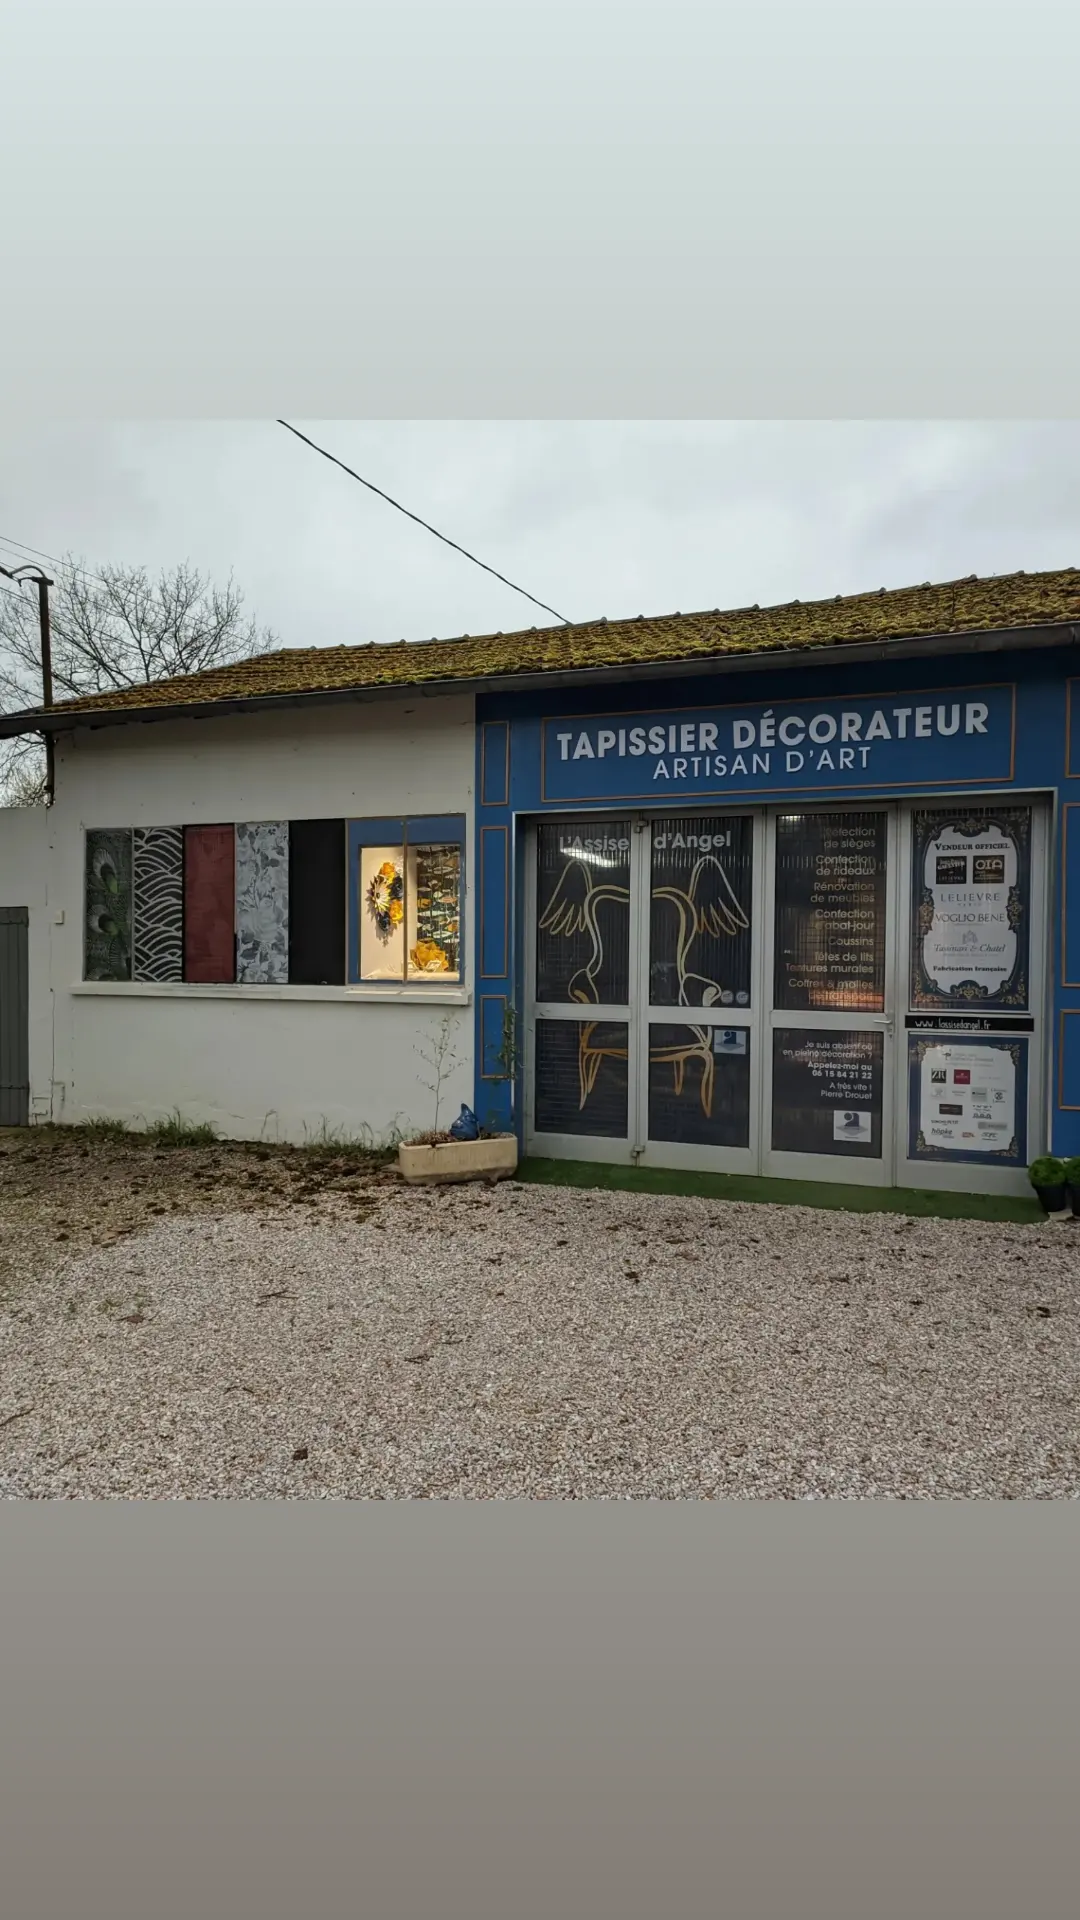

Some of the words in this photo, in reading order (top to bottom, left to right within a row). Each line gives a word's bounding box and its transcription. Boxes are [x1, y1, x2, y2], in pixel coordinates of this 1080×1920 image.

[558, 722, 718, 760] TAPISSIER
[733, 702, 988, 750] DÉCORATEUR
[653, 754, 770, 779] ARTISAN
[786, 747, 871, 773] D'ART
[560, 836, 629, 850] L'Assise
[654, 831, 731, 852] d'Angel
[824, 840, 838, 848] de
[841, 839, 876, 849] sièges
[816, 855, 875, 864] Confection
[816, 867, 831, 875] de
[834, 866, 875, 875] rideaux
[814, 882, 875, 891] Rénovation
[811, 894, 824, 902] de
[828, 894, 875, 902] meubles
[815, 909, 874, 919] Confection
[936, 914, 975, 922] VOGLIO
[978, 914, 1005, 922] BENE
[828, 936, 874, 945] Coussins
[979, 944, 1006, 952] Chatel
[815, 951, 840, 961] Têtes
[843, 952, 857, 961] de
[860, 953, 874, 962] lits
[786, 963, 828, 972] Tentures
[831, 964, 874, 973] murales
[827, 980, 835, 988] &
[837, 980, 874, 989] malles
[832, 1041, 860, 1050] absent
[821, 1050, 865, 1058] décoration
[808, 1061, 859, 1070] Appelez-moi
[821, 1090, 843, 1098] Pierre
[845, 1091, 872, 1099] Drouet
